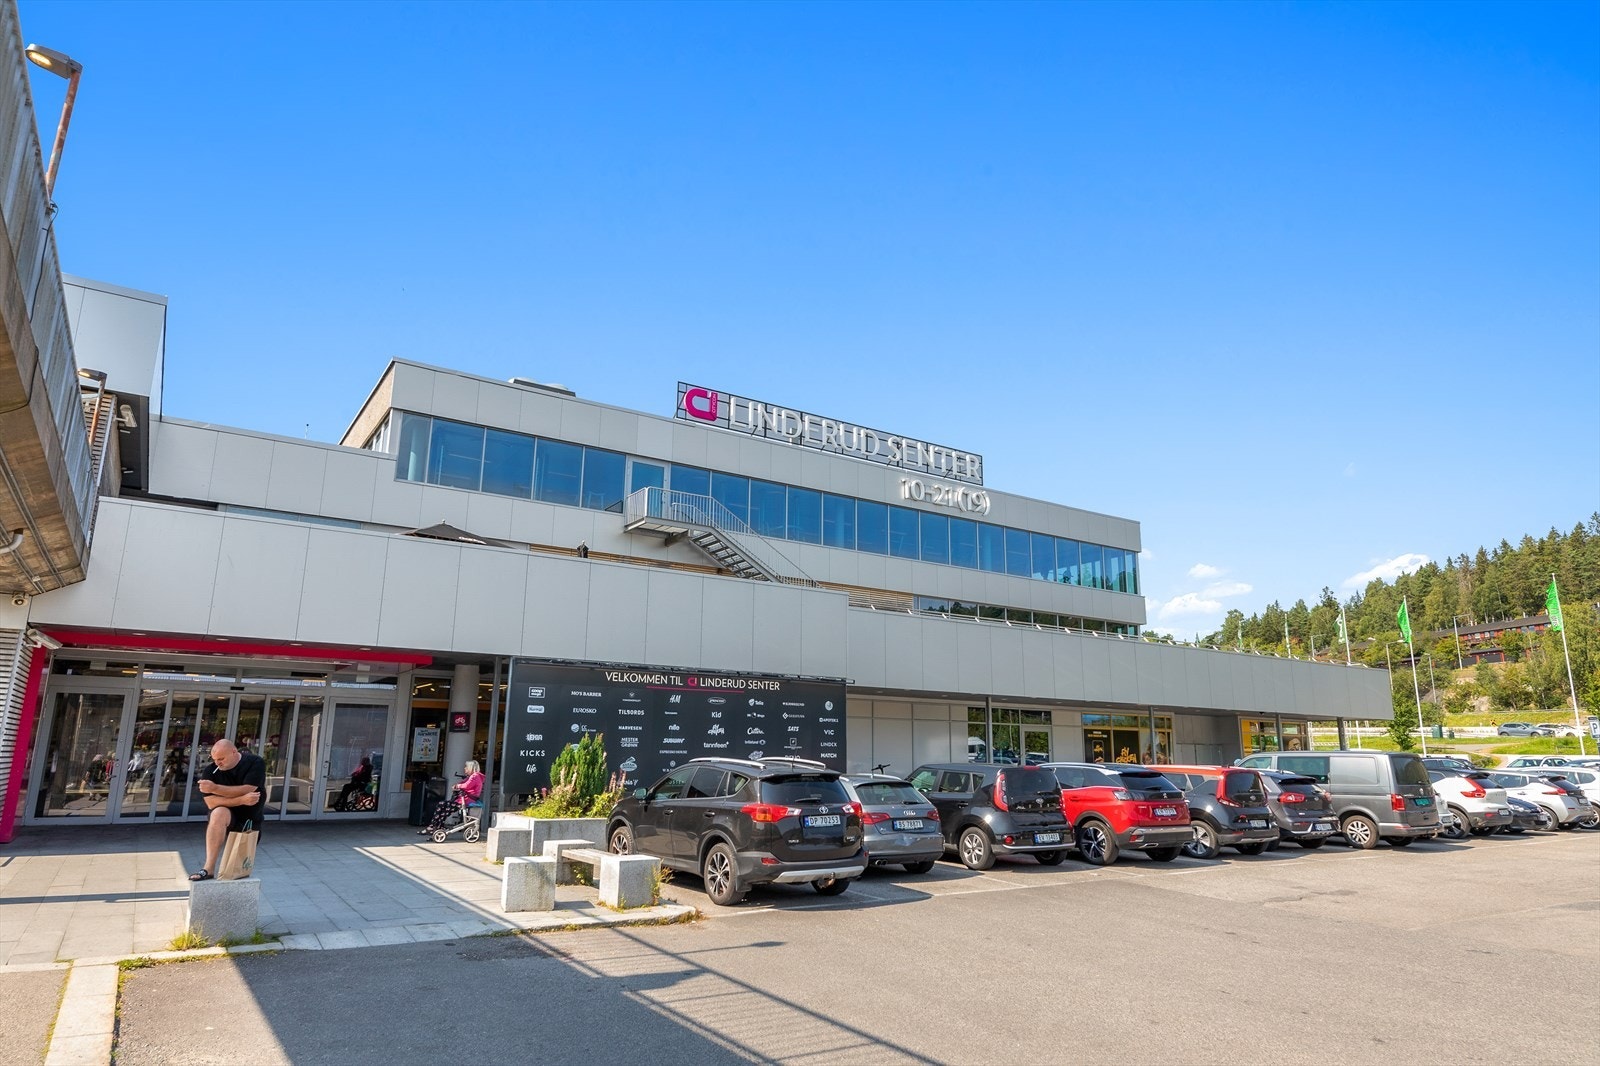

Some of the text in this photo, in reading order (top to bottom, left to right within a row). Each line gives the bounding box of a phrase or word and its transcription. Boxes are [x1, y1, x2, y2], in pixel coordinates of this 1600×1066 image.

[729, 396, 982, 481] LINDERUD SENTER
[605, 671, 668, 685] VELKOMMEN
[669, 677, 684, 686] TIL
[700, 677, 746, 689] LINDERUD
[747, 680, 780, 691] SENTER
[519, 749, 546, 757] KICKS
[526, 763, 537, 774] life
[809, 816, 839, 825] DP 70253
